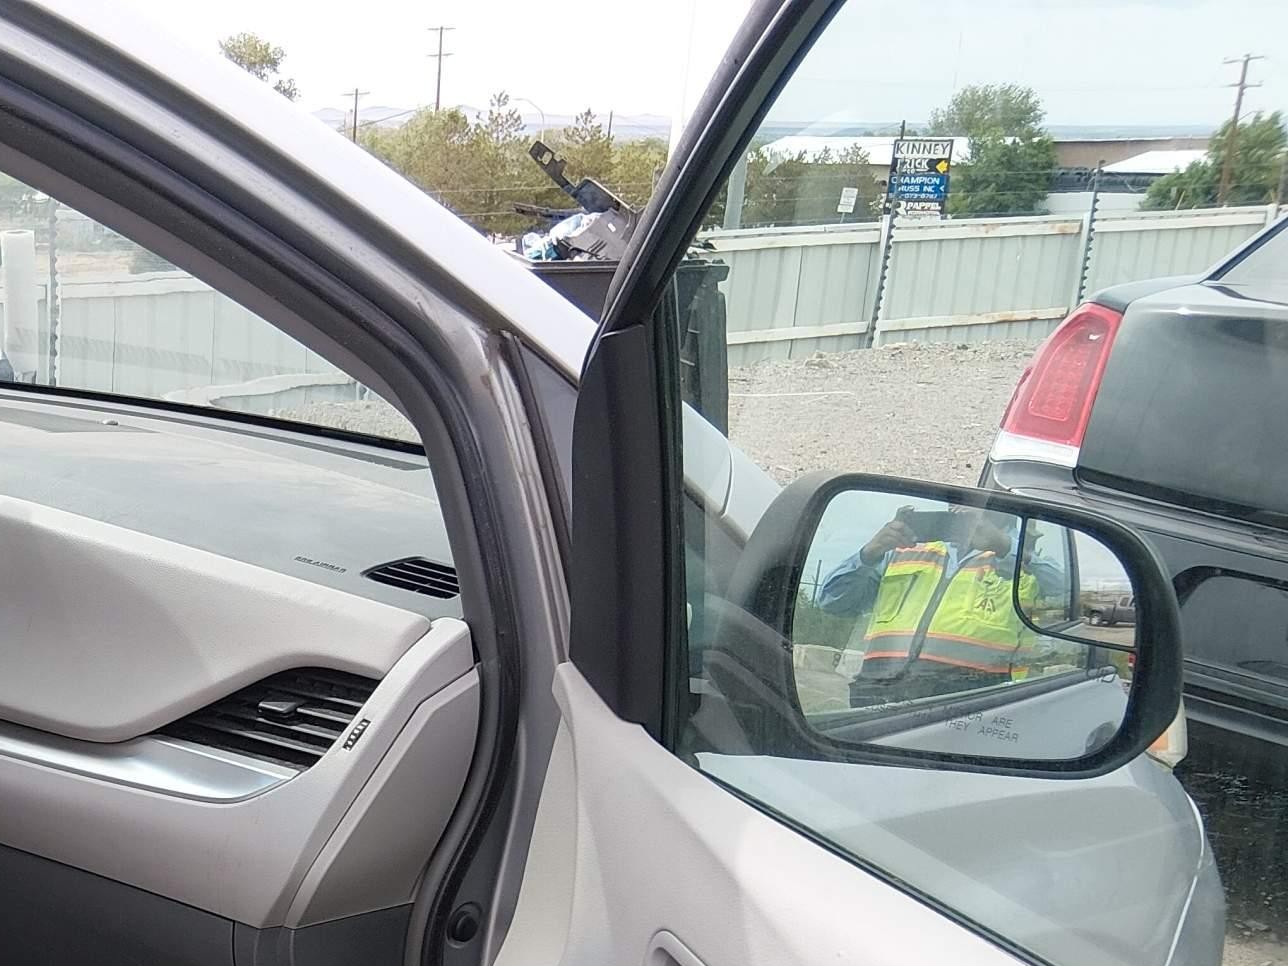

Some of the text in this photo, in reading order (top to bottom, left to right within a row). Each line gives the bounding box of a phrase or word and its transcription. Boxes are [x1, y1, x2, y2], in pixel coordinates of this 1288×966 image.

[896, 142, 950, 155] KINNEY
[991, 716, 1014, 729] ARE
[944, 719, 1020, 742] THEY APPEAR
